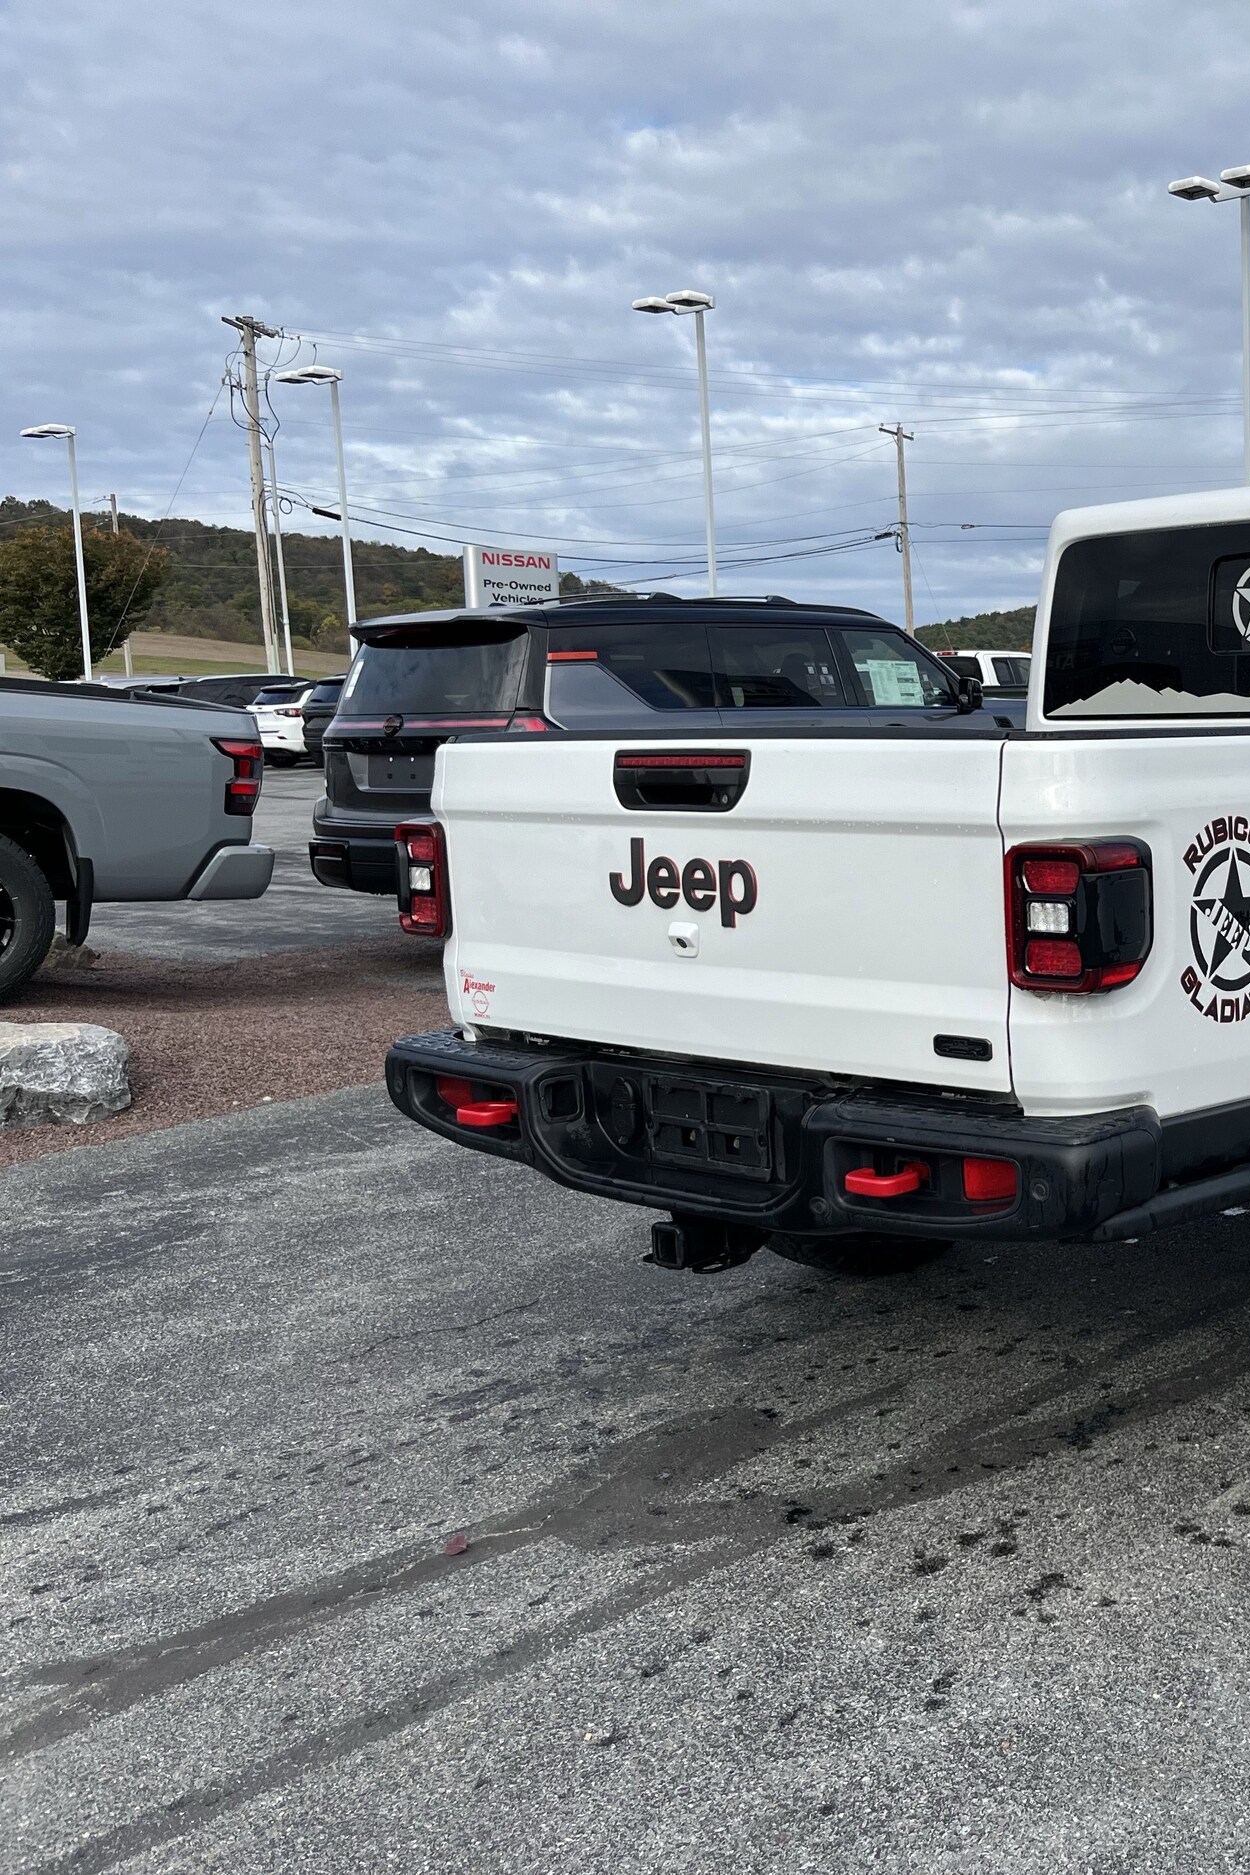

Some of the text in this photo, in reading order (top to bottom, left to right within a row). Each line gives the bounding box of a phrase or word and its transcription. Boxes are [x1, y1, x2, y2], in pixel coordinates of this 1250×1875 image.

[481, 552, 551, 570] NISSAN
[483, 578, 552, 592] Pre-Owned
[608, 836, 758, 929] Jeep
[463, 978, 497, 994] Alexander
